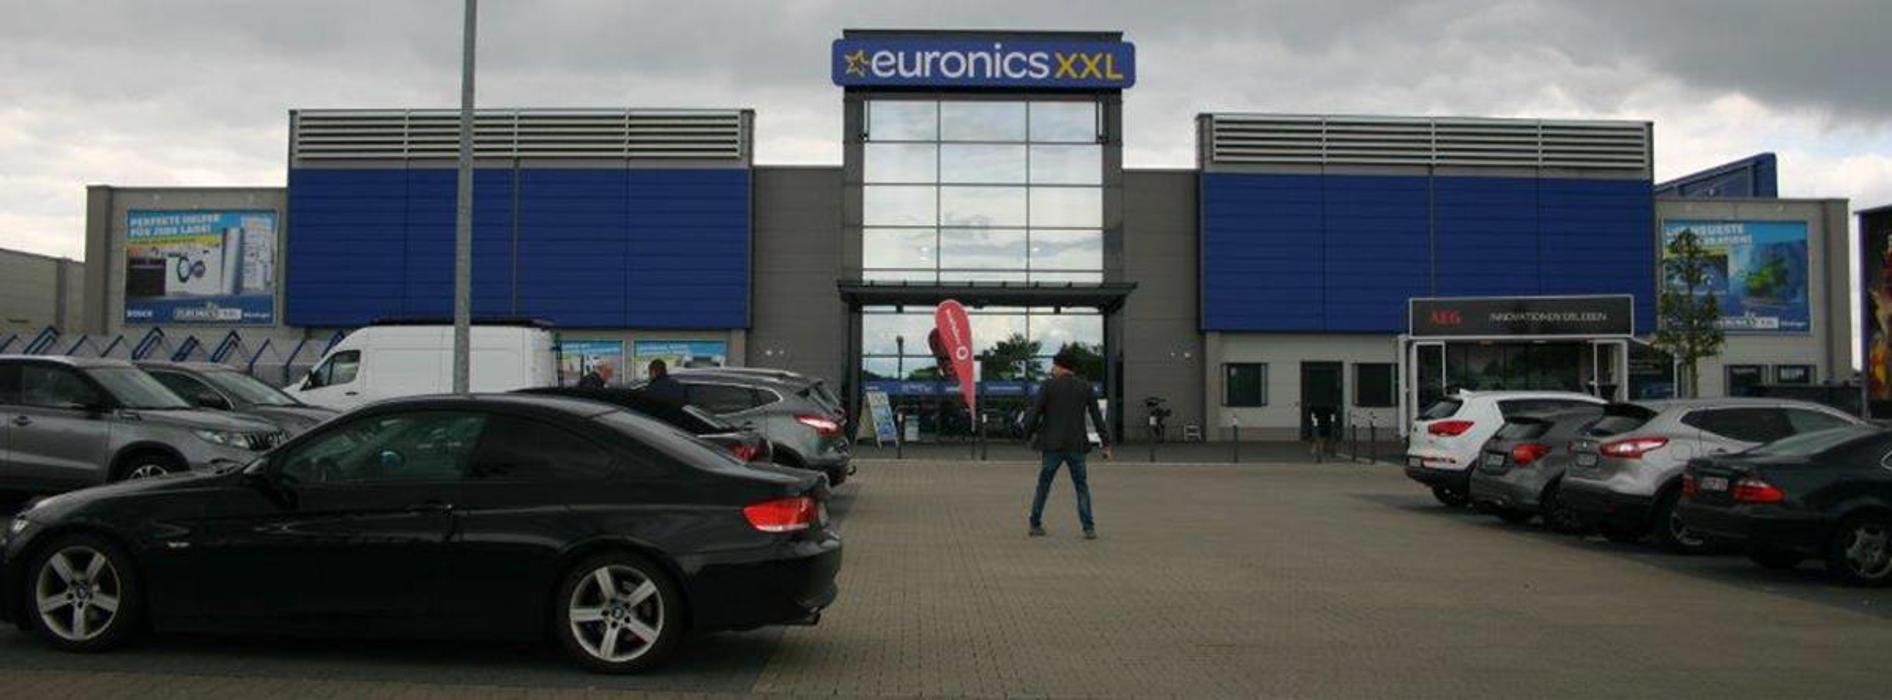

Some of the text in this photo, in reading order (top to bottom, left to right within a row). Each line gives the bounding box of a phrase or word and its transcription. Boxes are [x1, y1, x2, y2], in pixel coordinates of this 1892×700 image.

[871, 43, 1123, 80] euronics XXL
[127, 309, 153, 318] BOSCH
[1431, 310, 1461, 324] AEG
